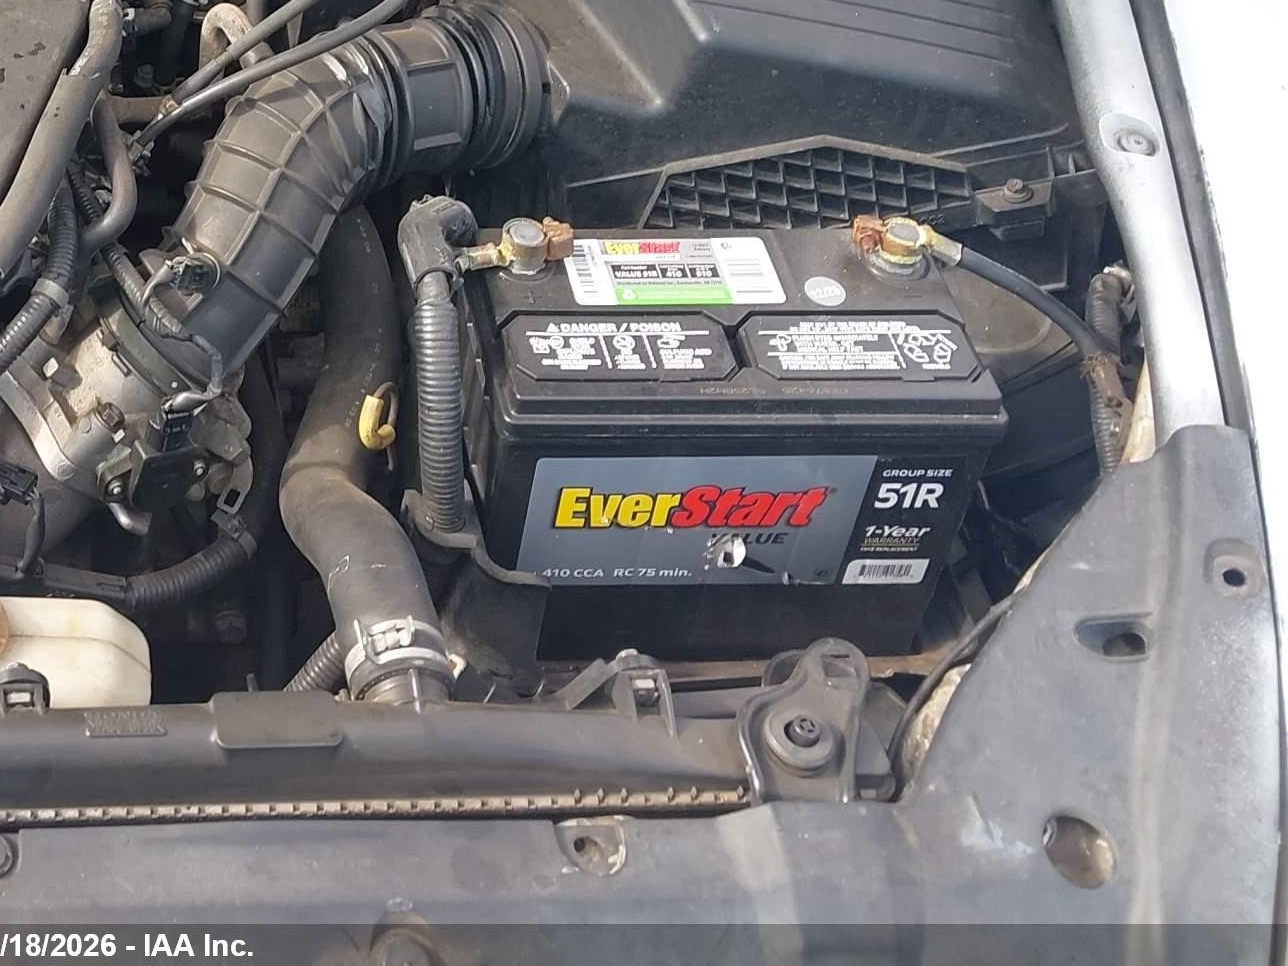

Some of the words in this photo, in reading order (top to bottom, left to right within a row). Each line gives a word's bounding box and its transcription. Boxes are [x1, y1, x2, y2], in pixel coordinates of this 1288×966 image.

[665, 270, 683, 278] 410
[560, 322, 617, 333] DANGER
[630, 322, 682, 332] POISON
[882, 469, 925, 477] GROUP
[926, 469, 953, 477] SIZE
[873, 483, 944, 509] 51R
[553, 484, 829, 529] EverStart
[865, 525, 931, 537] 1-Year
[542, 567, 569, 578] 410
[573, 567, 604, 578] CCA
[613, 567, 636, 578] RC
[638, 567, 657, 578] 75
[658, 567, 692, 578] min.
